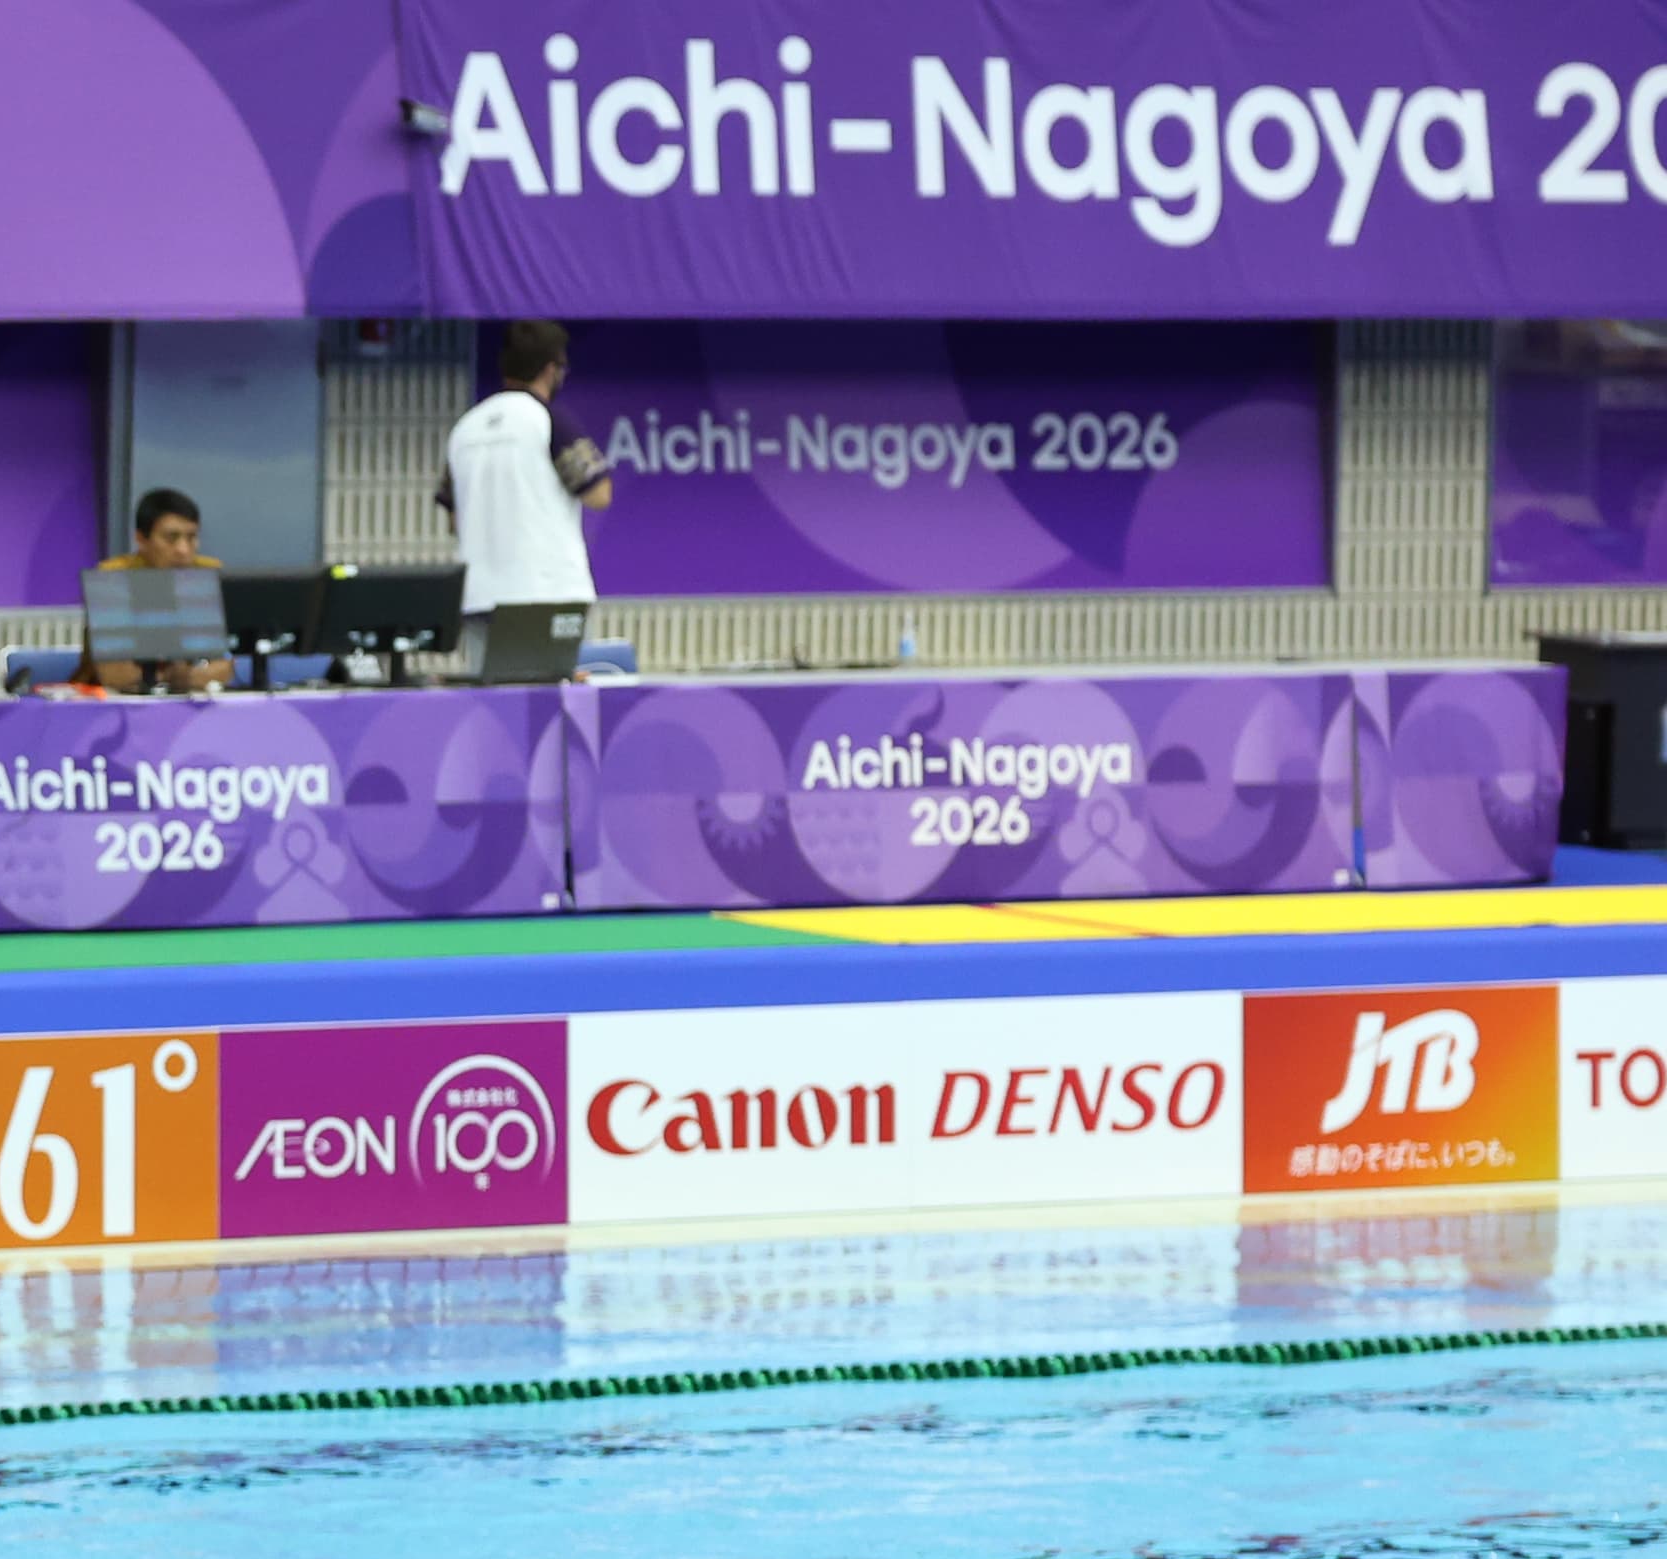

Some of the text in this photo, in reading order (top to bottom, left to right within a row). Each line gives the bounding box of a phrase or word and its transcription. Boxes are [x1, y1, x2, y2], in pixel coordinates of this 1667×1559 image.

[440, 33, 1495, 247] Aichi-Nagoya
[603, 411, 1179, 488] Aichi-Nagoya 2026
[801, 732, 1134, 796] Aichi-Nagoya
[93, 820, 225, 874] 2026
[908, 796, 1032, 848] 2026
[930, 1062, 1225, 1140] DENSO
[1319, 1008, 1481, 1135] JTB
[432, 1109, 539, 1173] 100
[586, 1079, 896, 1156] Canon
